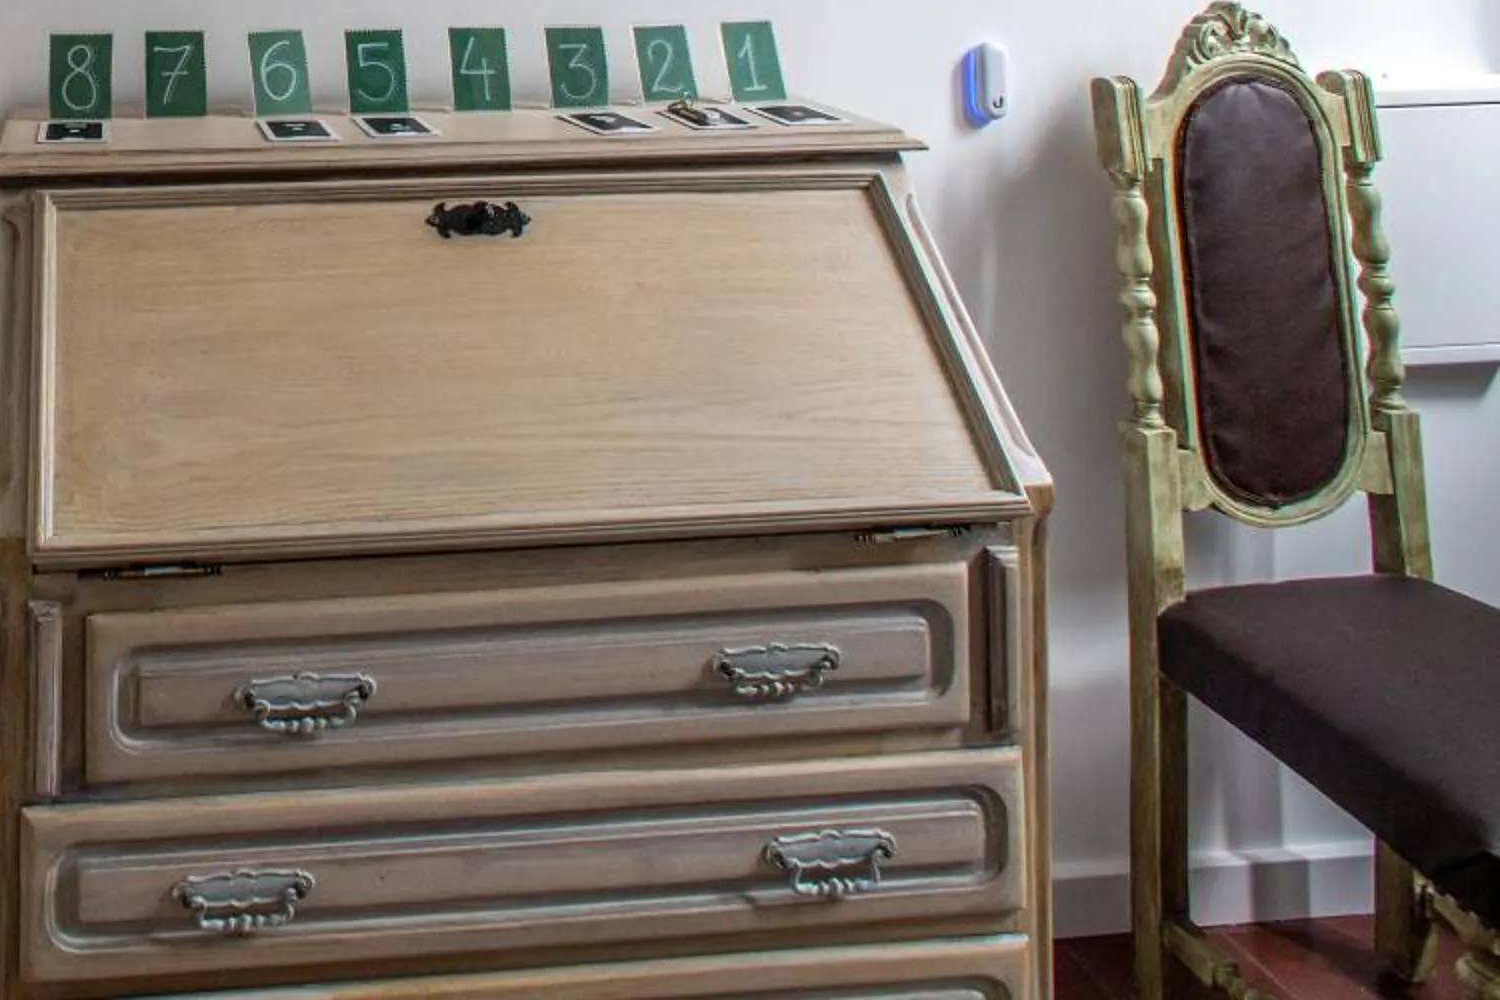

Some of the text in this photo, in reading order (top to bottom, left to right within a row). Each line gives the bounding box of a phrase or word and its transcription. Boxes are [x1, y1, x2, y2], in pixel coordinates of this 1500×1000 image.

[62, 44, 98, 111] 8
[153, 43, 193, 105] 7
[260, 40, 297, 101] 6
[357, 42, 395, 100] 5
[459, 35, 497, 101] 4
[559, 43, 597, 99] 3
[647, 39, 685, 93] 2
[737, 32, 768, 92] 1
